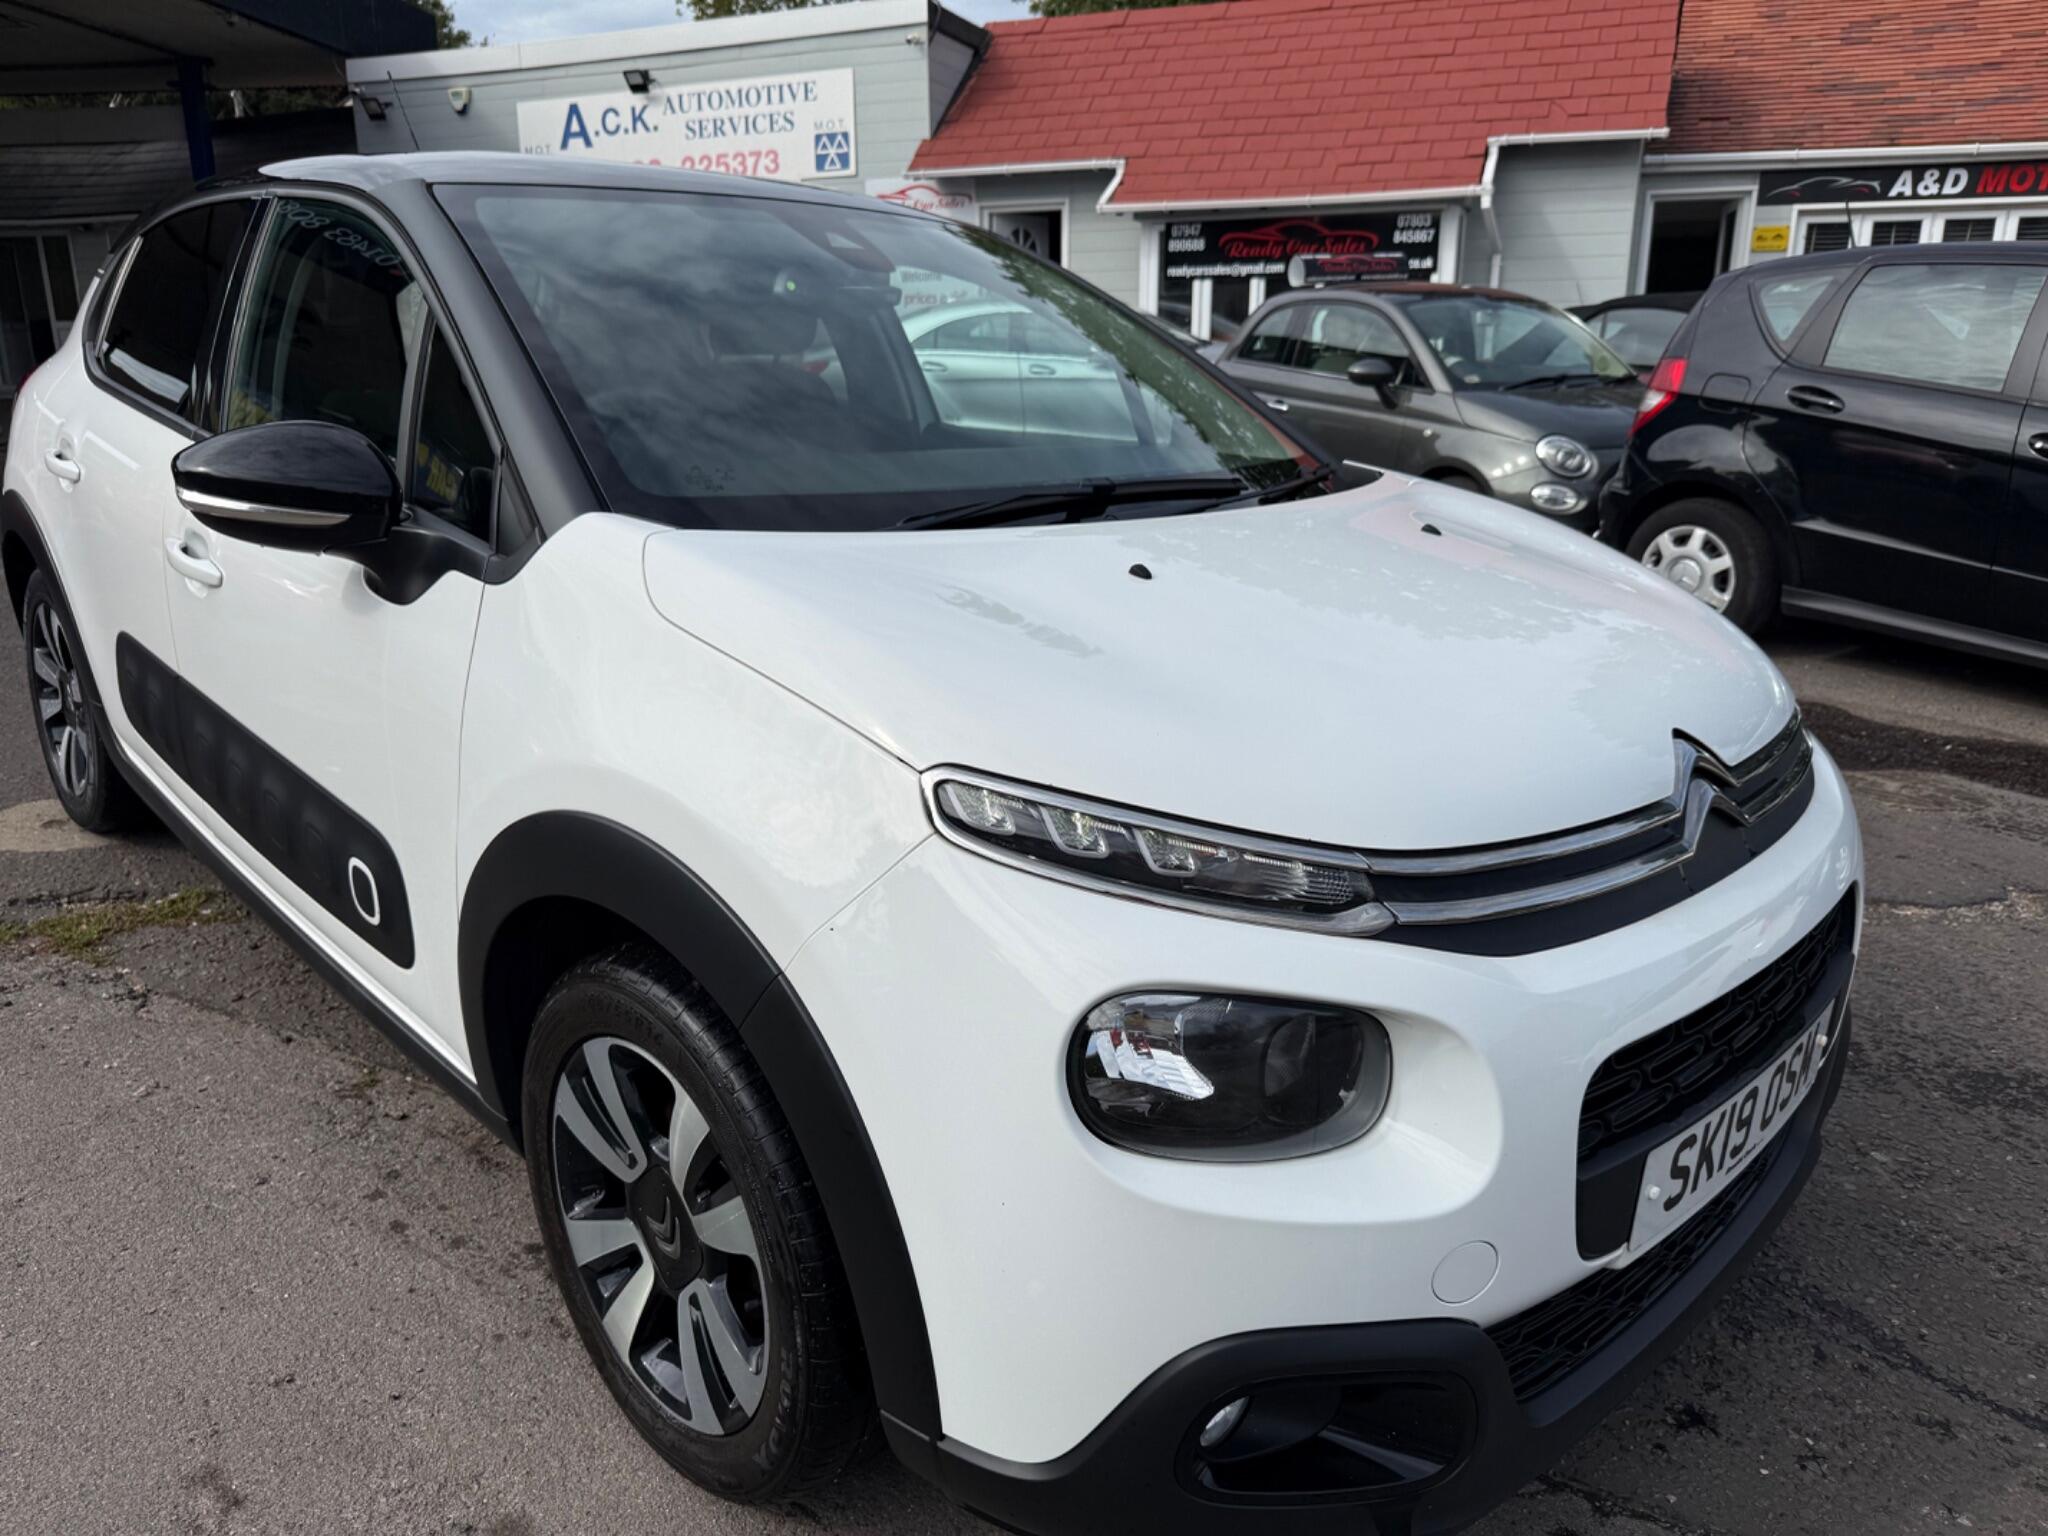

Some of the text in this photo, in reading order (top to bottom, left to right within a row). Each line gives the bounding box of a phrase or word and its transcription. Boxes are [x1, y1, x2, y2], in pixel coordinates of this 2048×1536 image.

[560, 80, 818, 150] A.C.K. AUTOMOTIVE
[685, 110, 795, 140] SERVICES
[1888, 168, 1969, 197] A&D
[1227, 239, 1283, 258] Ready
[1321, 238, 1367, 254] Sales
[1663, 1086, 1760, 1212] SK19
